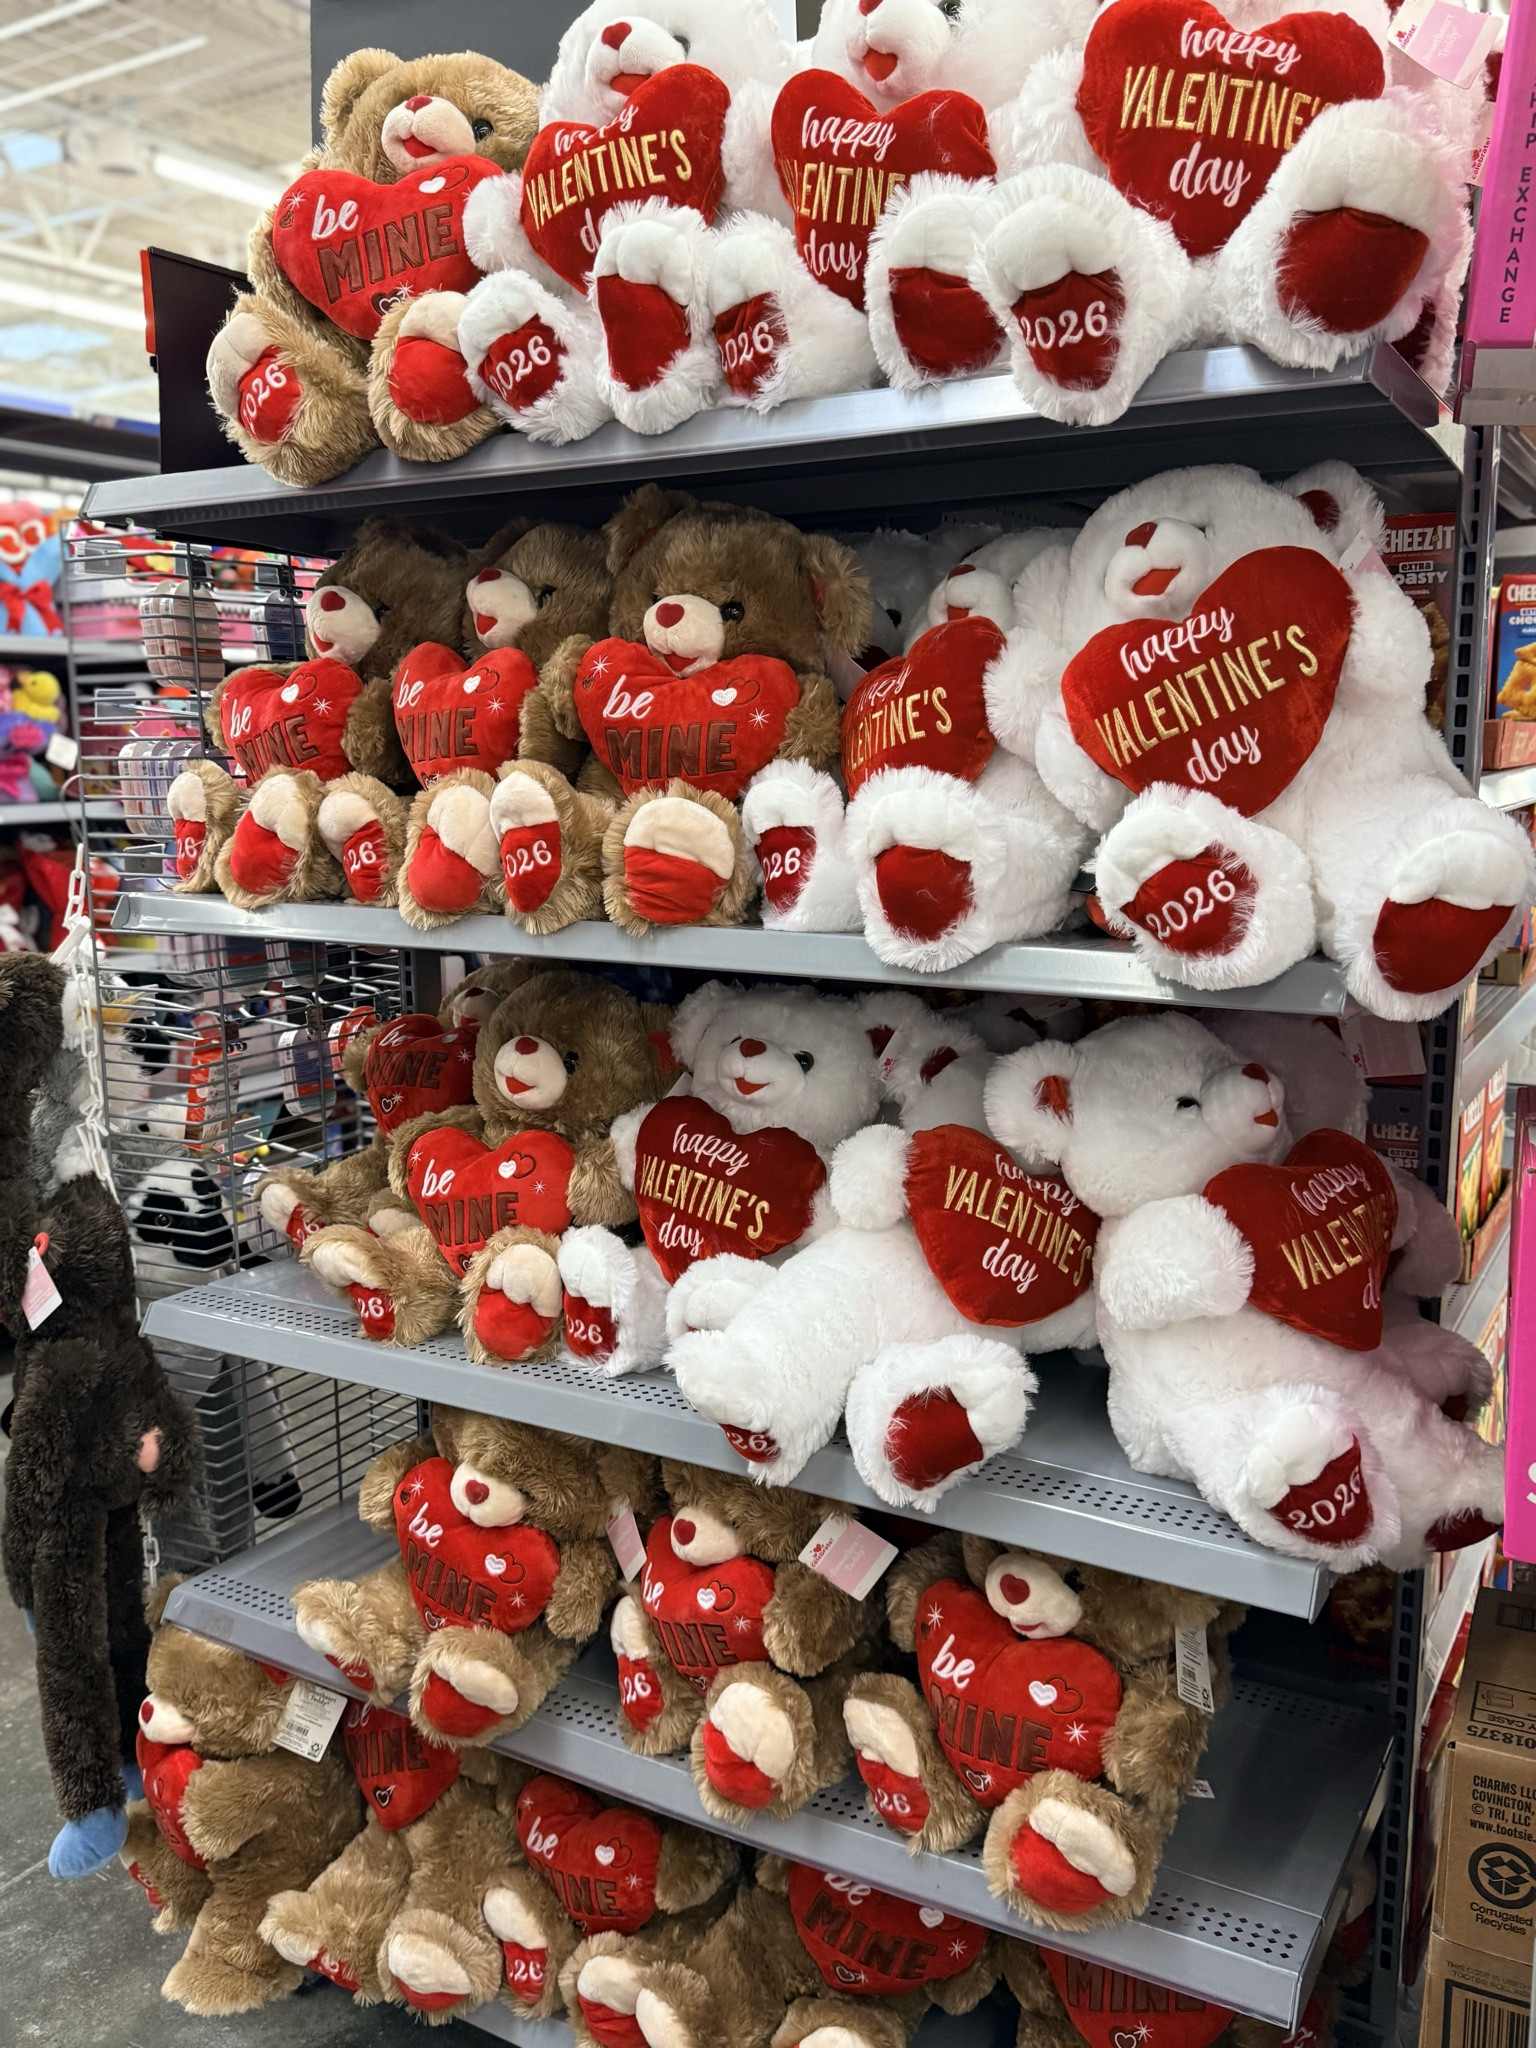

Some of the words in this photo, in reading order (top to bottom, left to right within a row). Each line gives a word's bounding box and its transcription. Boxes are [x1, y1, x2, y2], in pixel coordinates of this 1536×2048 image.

[1180, 18, 1300, 75] happy
[801, 105, 896, 162] happy
[526, 129, 693, 232] VALENTINE'S
[1170, 141, 1252, 208] day
[311, 194, 361, 240] be
[317, 203, 460, 304] MINE
[804, 229, 862, 281] day
[1021, 301, 1108, 350] 2026
[1120, 606, 1235, 681] happy
[396, 668, 425, 708] be
[602, 675, 655, 719] be
[1095, 624, 1319, 769] VALENTINE'S
[231, 697, 251, 739] be
[397, 706, 479, 764] MINE
[236, 713, 319, 786] MINE
[605, 720, 738, 780] MINE
[1187, 725, 1259, 785] day
[1146, 870, 1236, 941] 2026
[672, 1123, 751, 1176] happy
[421, 1159, 456, 1198] be
[640, 1153, 770, 1241] VALENTINE'S
[1290, 1163, 1372, 1217] happy
[426, 1192, 519, 1247] MINE
[658, 1213, 705, 1257] day
[944, 1165, 1094, 1288] VALENTINE'S
[982, 1238, 1039, 1294] day
[408, 1502, 443, 1549] be
[1289, 1467, 1362, 1529] 2026
[406, 1540, 498, 1629] MINE
[642, 1561, 665, 1612] be
[931, 1634, 976, 1689] be
[930, 1681, 1054, 1774] MINE
[1487, 1713, 1525, 1728] CASE
[345, 1723, 430, 1778] MINE
[1472, 1788, 1535, 1817] COVINGTON,
[1473, 1775, 1517, 1796] CHARMS
[527, 1816, 558, 1859] be
[1488, 1806, 1509, 1824] TRI,
[1512, 1812, 1531, 1828] LLC
[804, 1895, 938, 1981] MINE
[1470, 1902, 1533, 1927] Corrugated
[1475, 1913, 1527, 1936] Recycles
